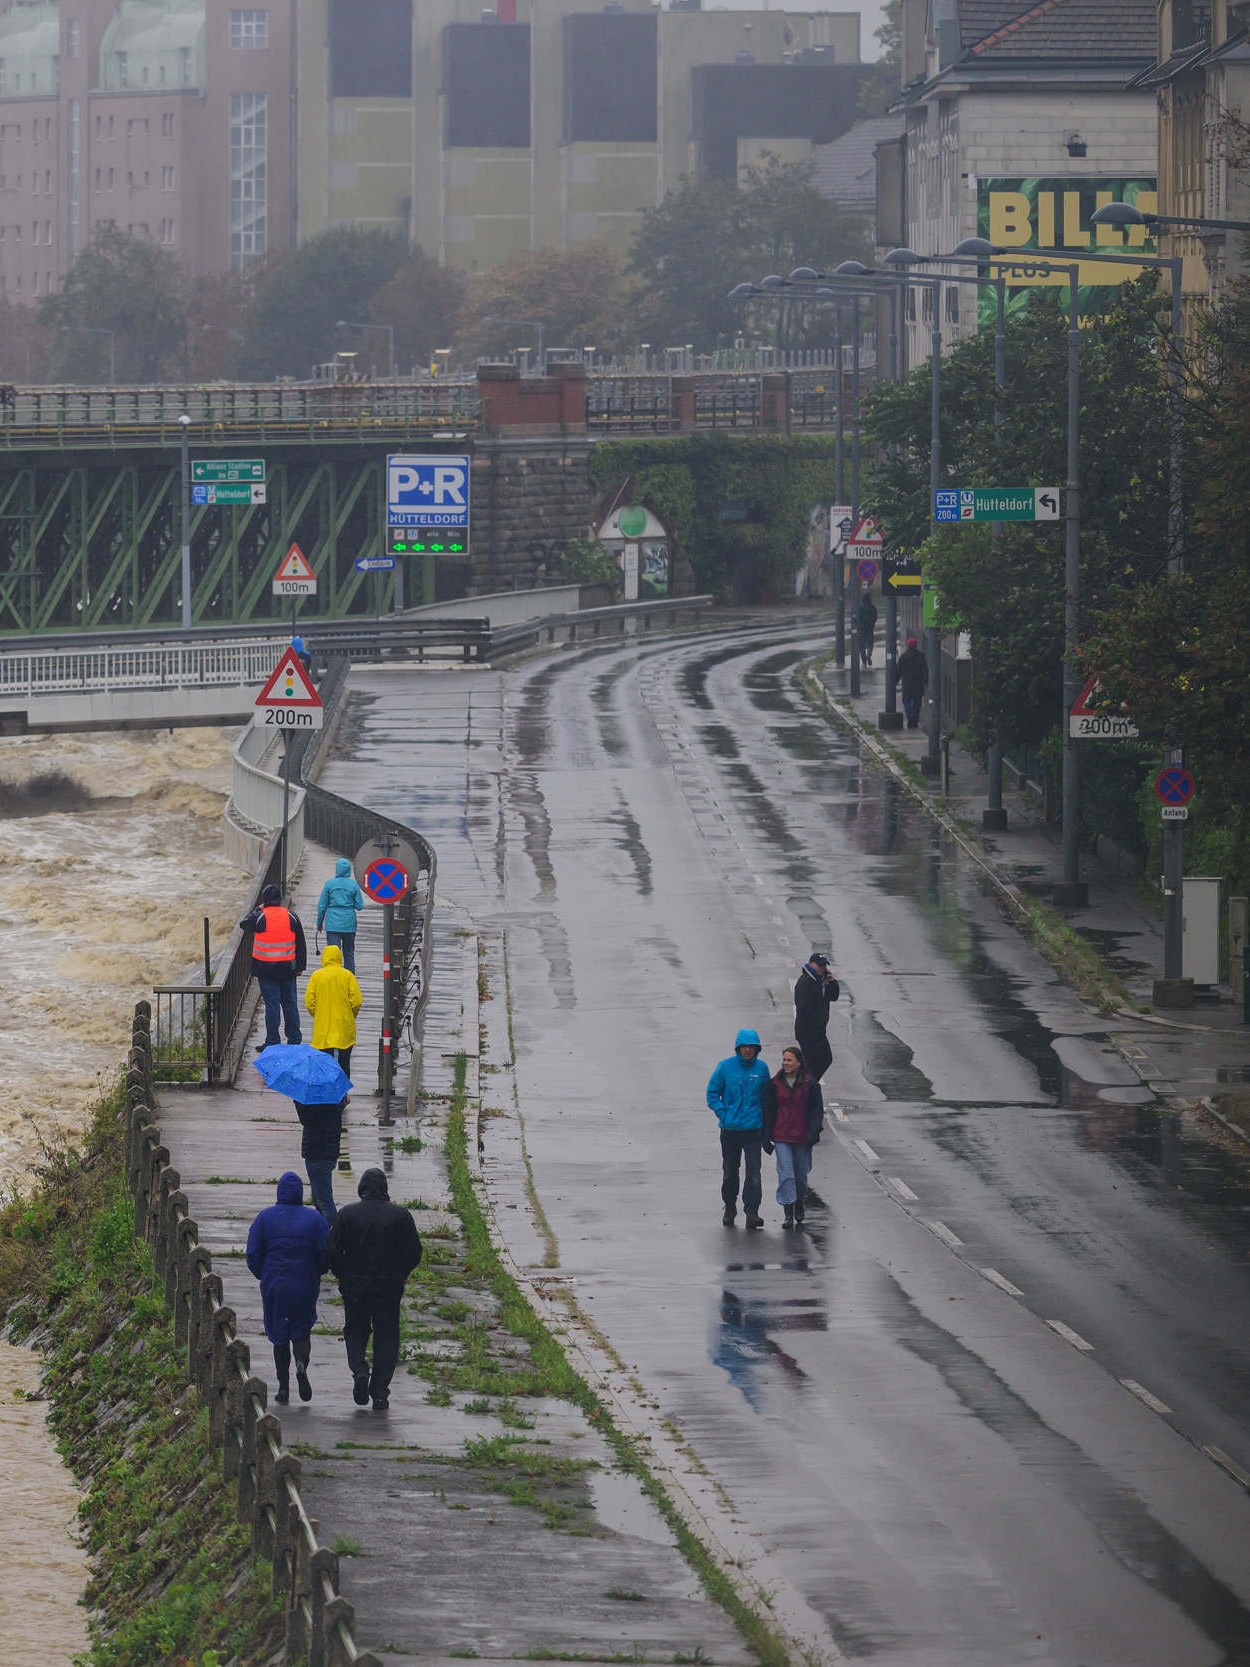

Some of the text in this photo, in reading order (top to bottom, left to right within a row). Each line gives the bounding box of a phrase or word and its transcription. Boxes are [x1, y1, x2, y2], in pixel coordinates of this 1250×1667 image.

[998, 261, 1051, 278] PLUS
[228, 462, 251, 470] Stadion
[389, 467, 466, 504] P+R
[217, 490, 250, 498] Hütteldorf
[937, 495, 957, 505] P+R
[976, 498, 1033, 511] Hütteldorf
[390, 513, 465, 524] HÜTTELDORF
[855, 547, 882, 557] 100m
[281, 582, 309, 592] 100m
[265, 709, 312, 725] 200m
[1081, 718, 1128, 734] 200m
[1164, 809, 1186, 818] Anfang
